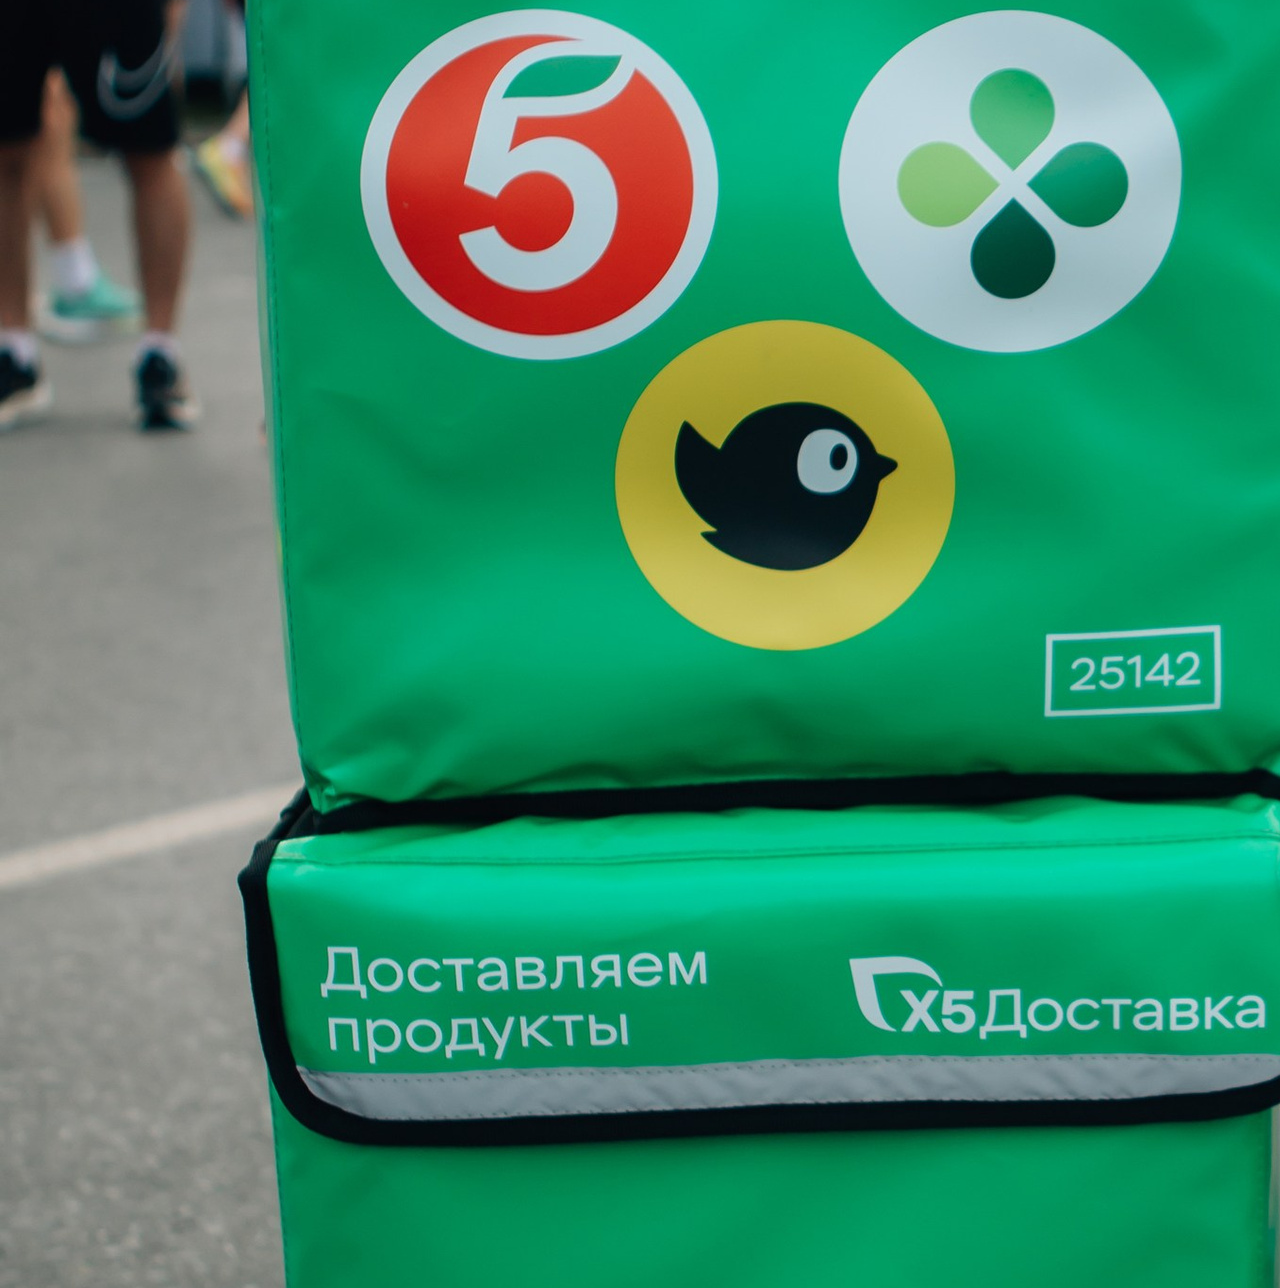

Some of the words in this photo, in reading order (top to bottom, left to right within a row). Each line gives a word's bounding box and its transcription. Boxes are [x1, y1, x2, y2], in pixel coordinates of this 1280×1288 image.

[1070, 651, 1201, 691] 25142
[320, 946, 708, 999] Доставляем
[328, 1014, 629, 1064] продукты
